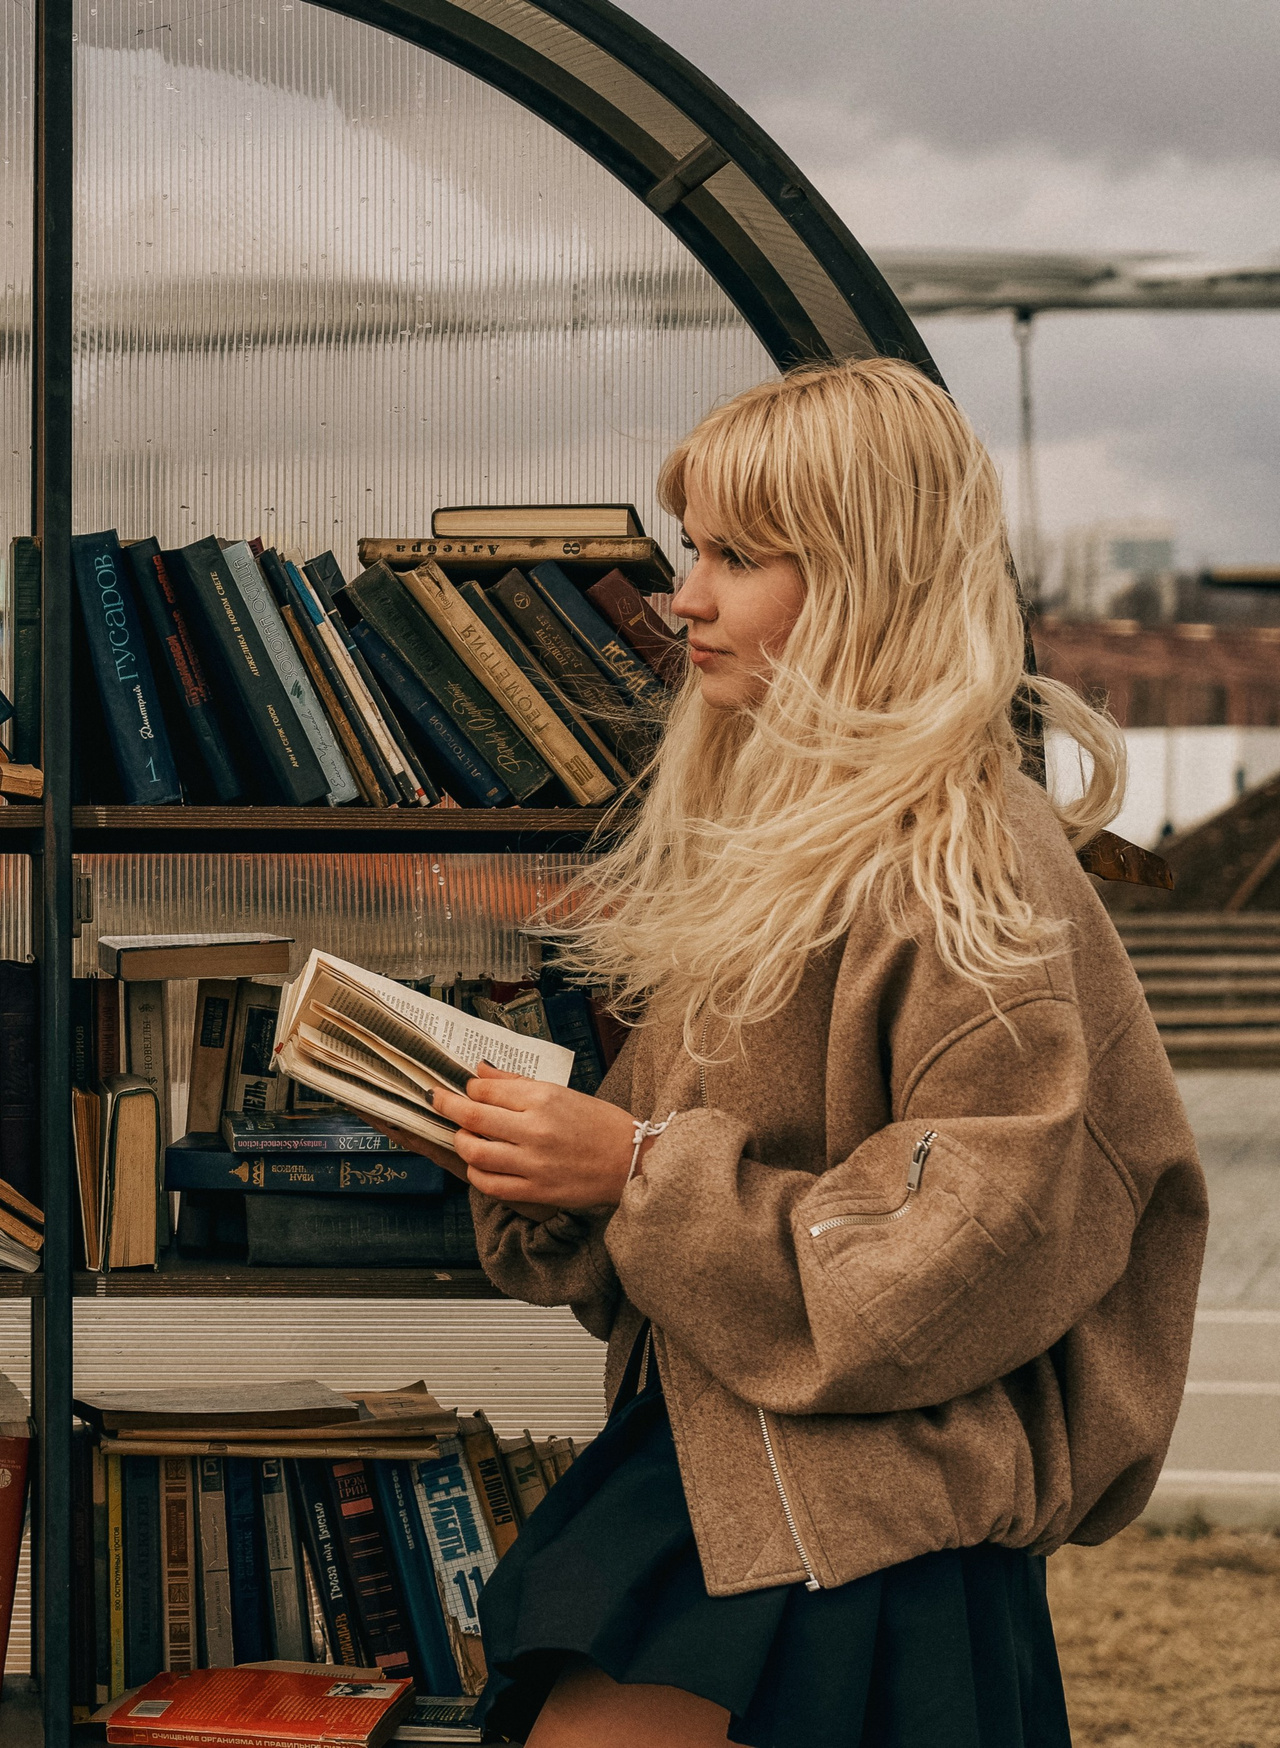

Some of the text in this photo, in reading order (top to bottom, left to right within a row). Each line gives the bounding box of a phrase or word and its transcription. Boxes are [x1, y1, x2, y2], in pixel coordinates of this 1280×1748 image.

[395, 542, 580, 555] 8 Алгебра
[208, 569, 225, 596] СВЕТЕ
[219, 595, 238, 627] НОВОМ
[536, 612, 554, 633] ЛЕТ
[91, 552, 156, 740] Дмитрий Гусаров
[235, 632, 261, 678] АНЖЕЛИКА
[535, 626, 569, 667] ПОВЕСТИ
[458, 622, 550, 734] ГЕОМЕТРИЯ
[265, 703, 281, 728] ГОЛОН
[276, 726, 290, 747] СЕРЖ
[287, 752, 300, 769] АНН
[74, 1025, 85, 1080] СМИРНОВ
[141, 1020, 153, 1070] НОВЕЛЛЫ
[237, 1136, 381, 1149] #27-28 Fantasy&ScienceFiction
[271, 1164, 334, 1174] ЛЧНИКОВ
[289, 1173, 314, 1182] ИВАН
[336, 1474, 366, 1488] ГРЭМ
[337, 1483, 368, 1498] ГРИН
[477, 1456, 513, 1526] БИОЛОГИЯ
[389, 1468, 416, 1550] ШЕСТОЙ ОСТРОВ
[428, 1497, 466, 1562] РАБОТЫ
[453, 1494, 482, 1555] ДОМАШНИЕ
[113, 1553, 121, 1598] ОСТРОУМНЫХ
[151, 1732, 200, 1743] ОЧИЩЕНИЕ
[201, 1735, 255, 1746] ОРГАНИЗМА
